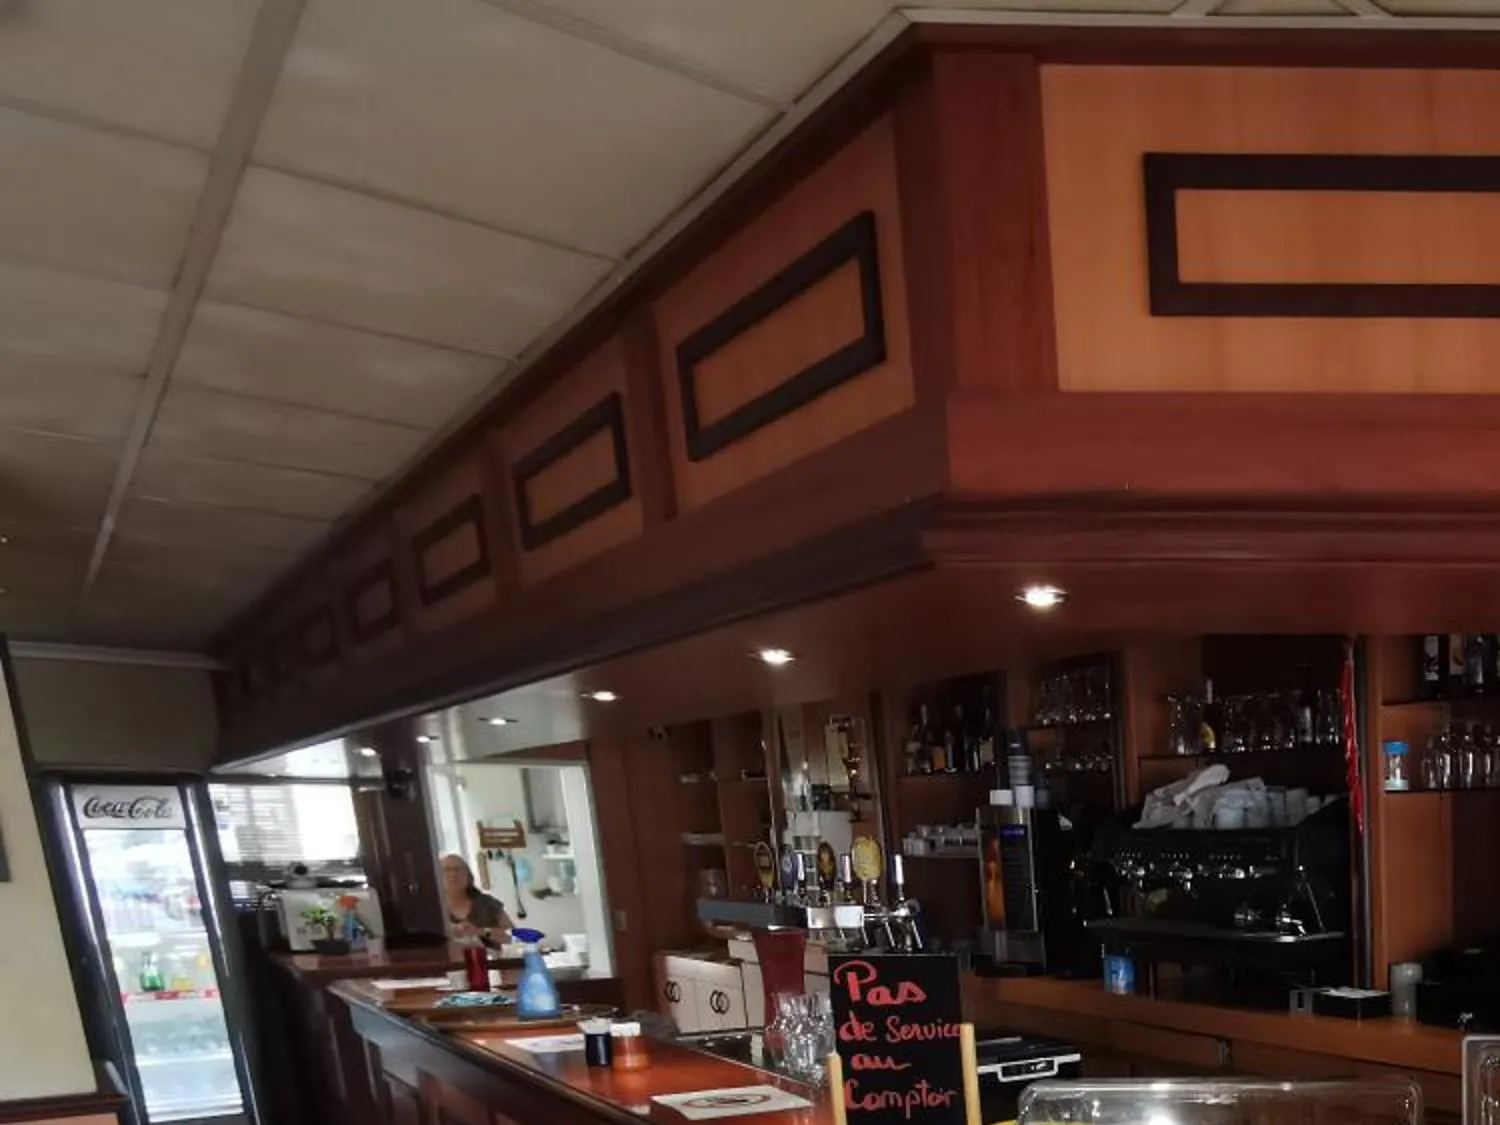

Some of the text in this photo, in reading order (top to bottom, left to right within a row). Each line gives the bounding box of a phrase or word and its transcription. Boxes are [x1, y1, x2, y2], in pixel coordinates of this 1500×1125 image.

[833, 960, 927, 1006] Pas
[839, 1009, 877, 1042] de
[851, 1053, 912, 1071] au
[844, 1079, 958, 1119] Comptoir
